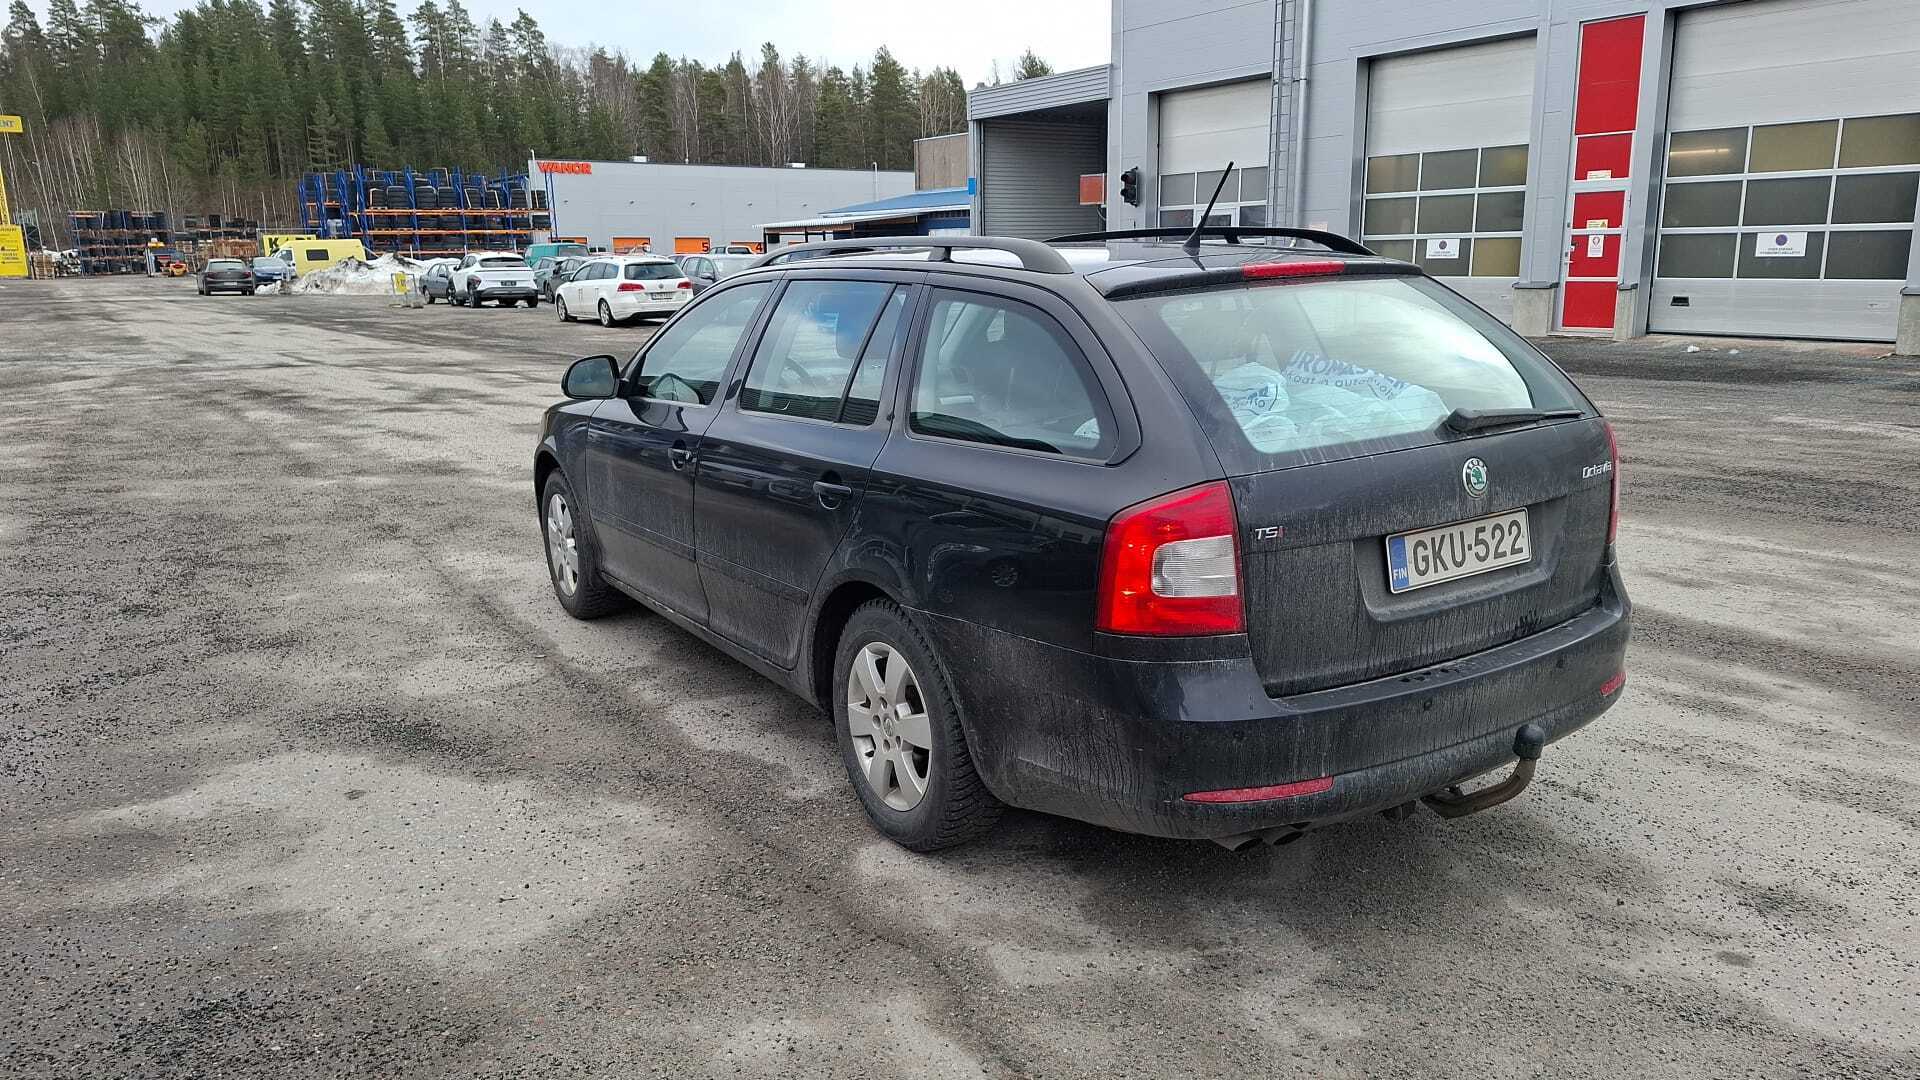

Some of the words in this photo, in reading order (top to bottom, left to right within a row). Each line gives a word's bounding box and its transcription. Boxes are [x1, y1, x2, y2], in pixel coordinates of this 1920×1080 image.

[702, 242, 709, 252] 5
[756, 243, 762, 252] 4
[1413, 519, 1524, 577] GKU-522
[1393, 567, 1407, 580] FIN
